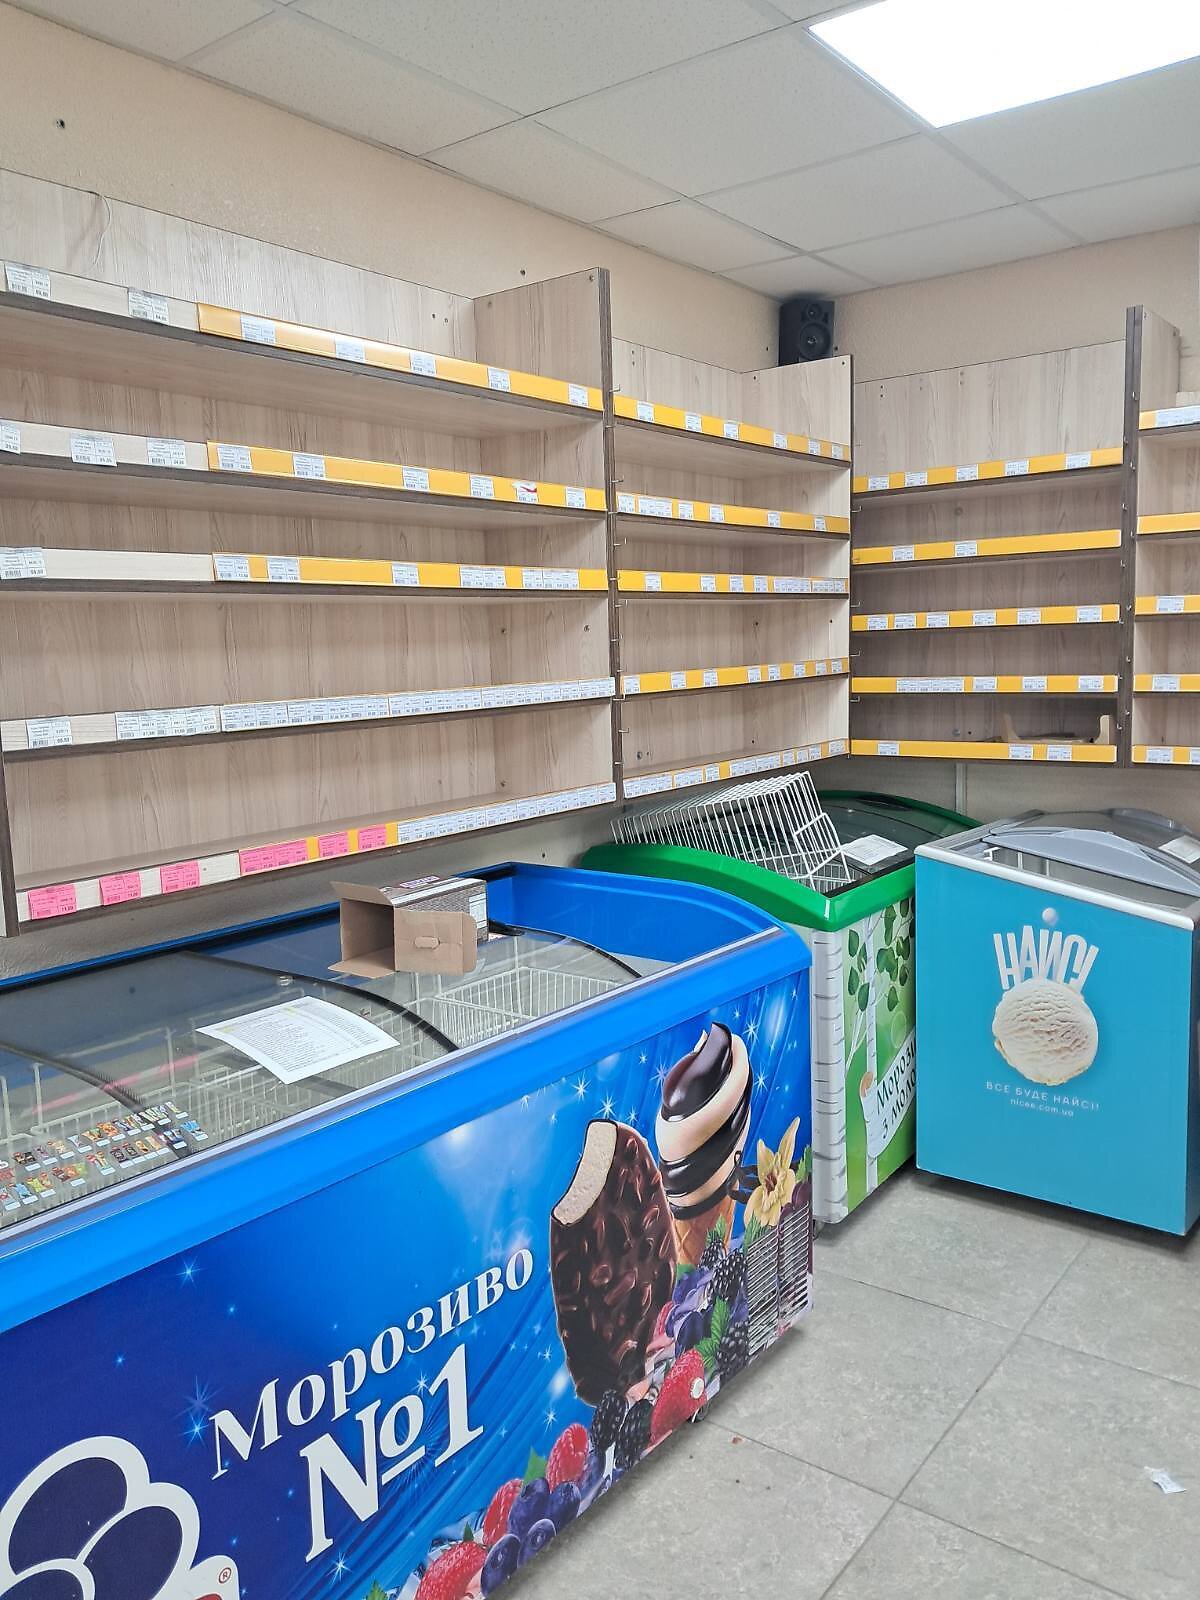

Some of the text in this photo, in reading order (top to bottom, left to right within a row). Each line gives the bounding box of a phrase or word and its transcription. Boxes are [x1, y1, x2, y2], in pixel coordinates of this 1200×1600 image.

[985, 1080, 1011, 1094] ВСЕ
[1015, 1087, 1049, 1101] БУДЕ
[1010, 1098, 1075, 1118] nicee.com.ua
[209, 1248, 534, 1481] Морозиво
